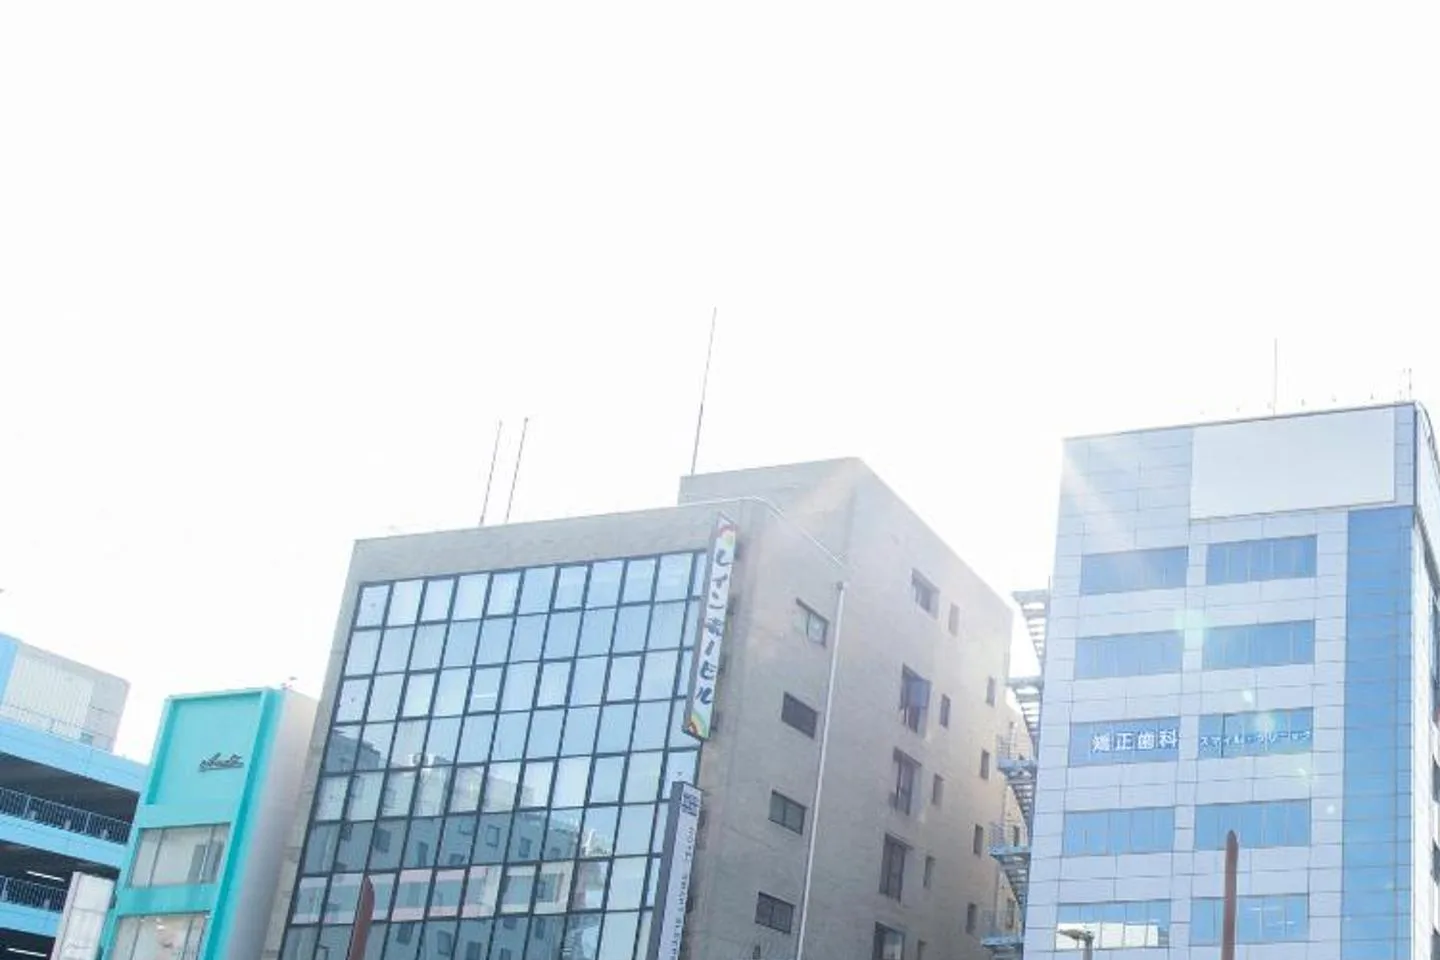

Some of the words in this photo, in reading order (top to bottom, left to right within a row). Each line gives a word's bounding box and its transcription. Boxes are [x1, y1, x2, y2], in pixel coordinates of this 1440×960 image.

[695, 548, 731, 706] レインボービル
